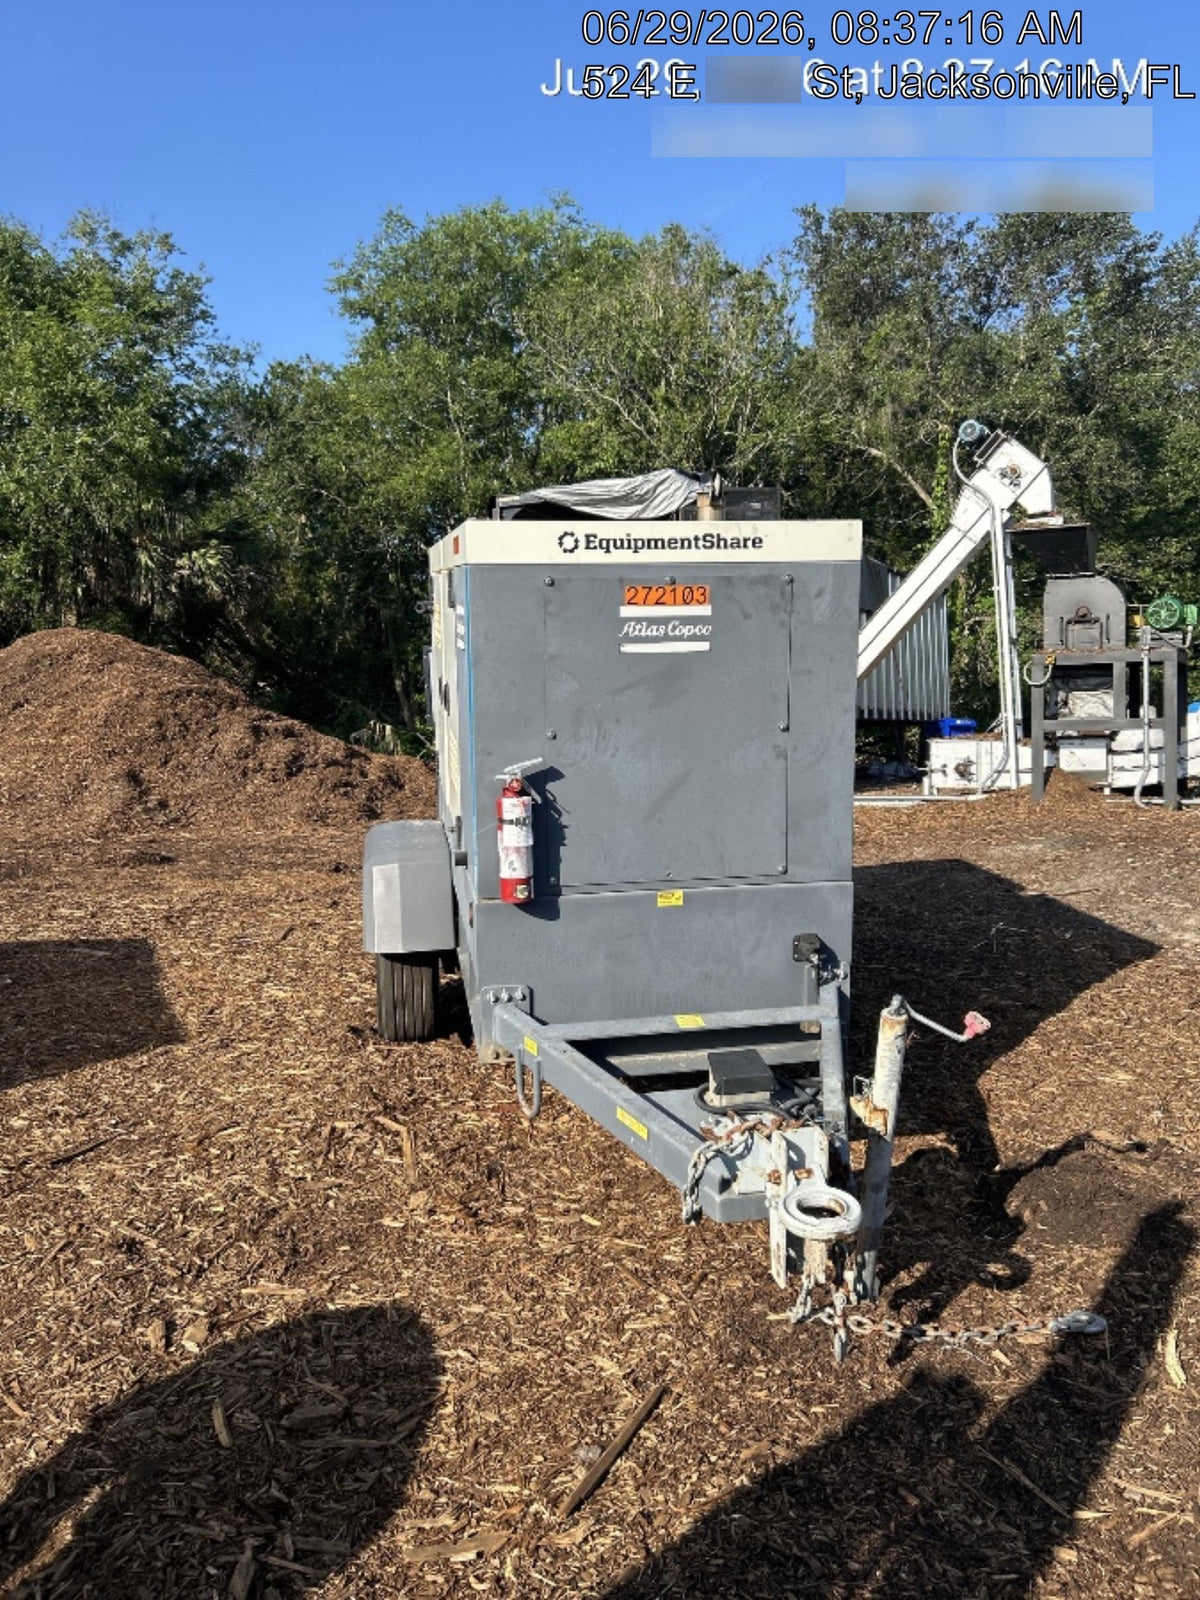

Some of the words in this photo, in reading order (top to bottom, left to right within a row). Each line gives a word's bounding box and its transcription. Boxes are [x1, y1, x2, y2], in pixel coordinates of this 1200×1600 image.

[584, 533, 763, 553] EquipmentShare
[626, 586, 708, 605] 272103
[619, 621, 666, 638] Atlas
[667, 620, 712, 638] Copco
